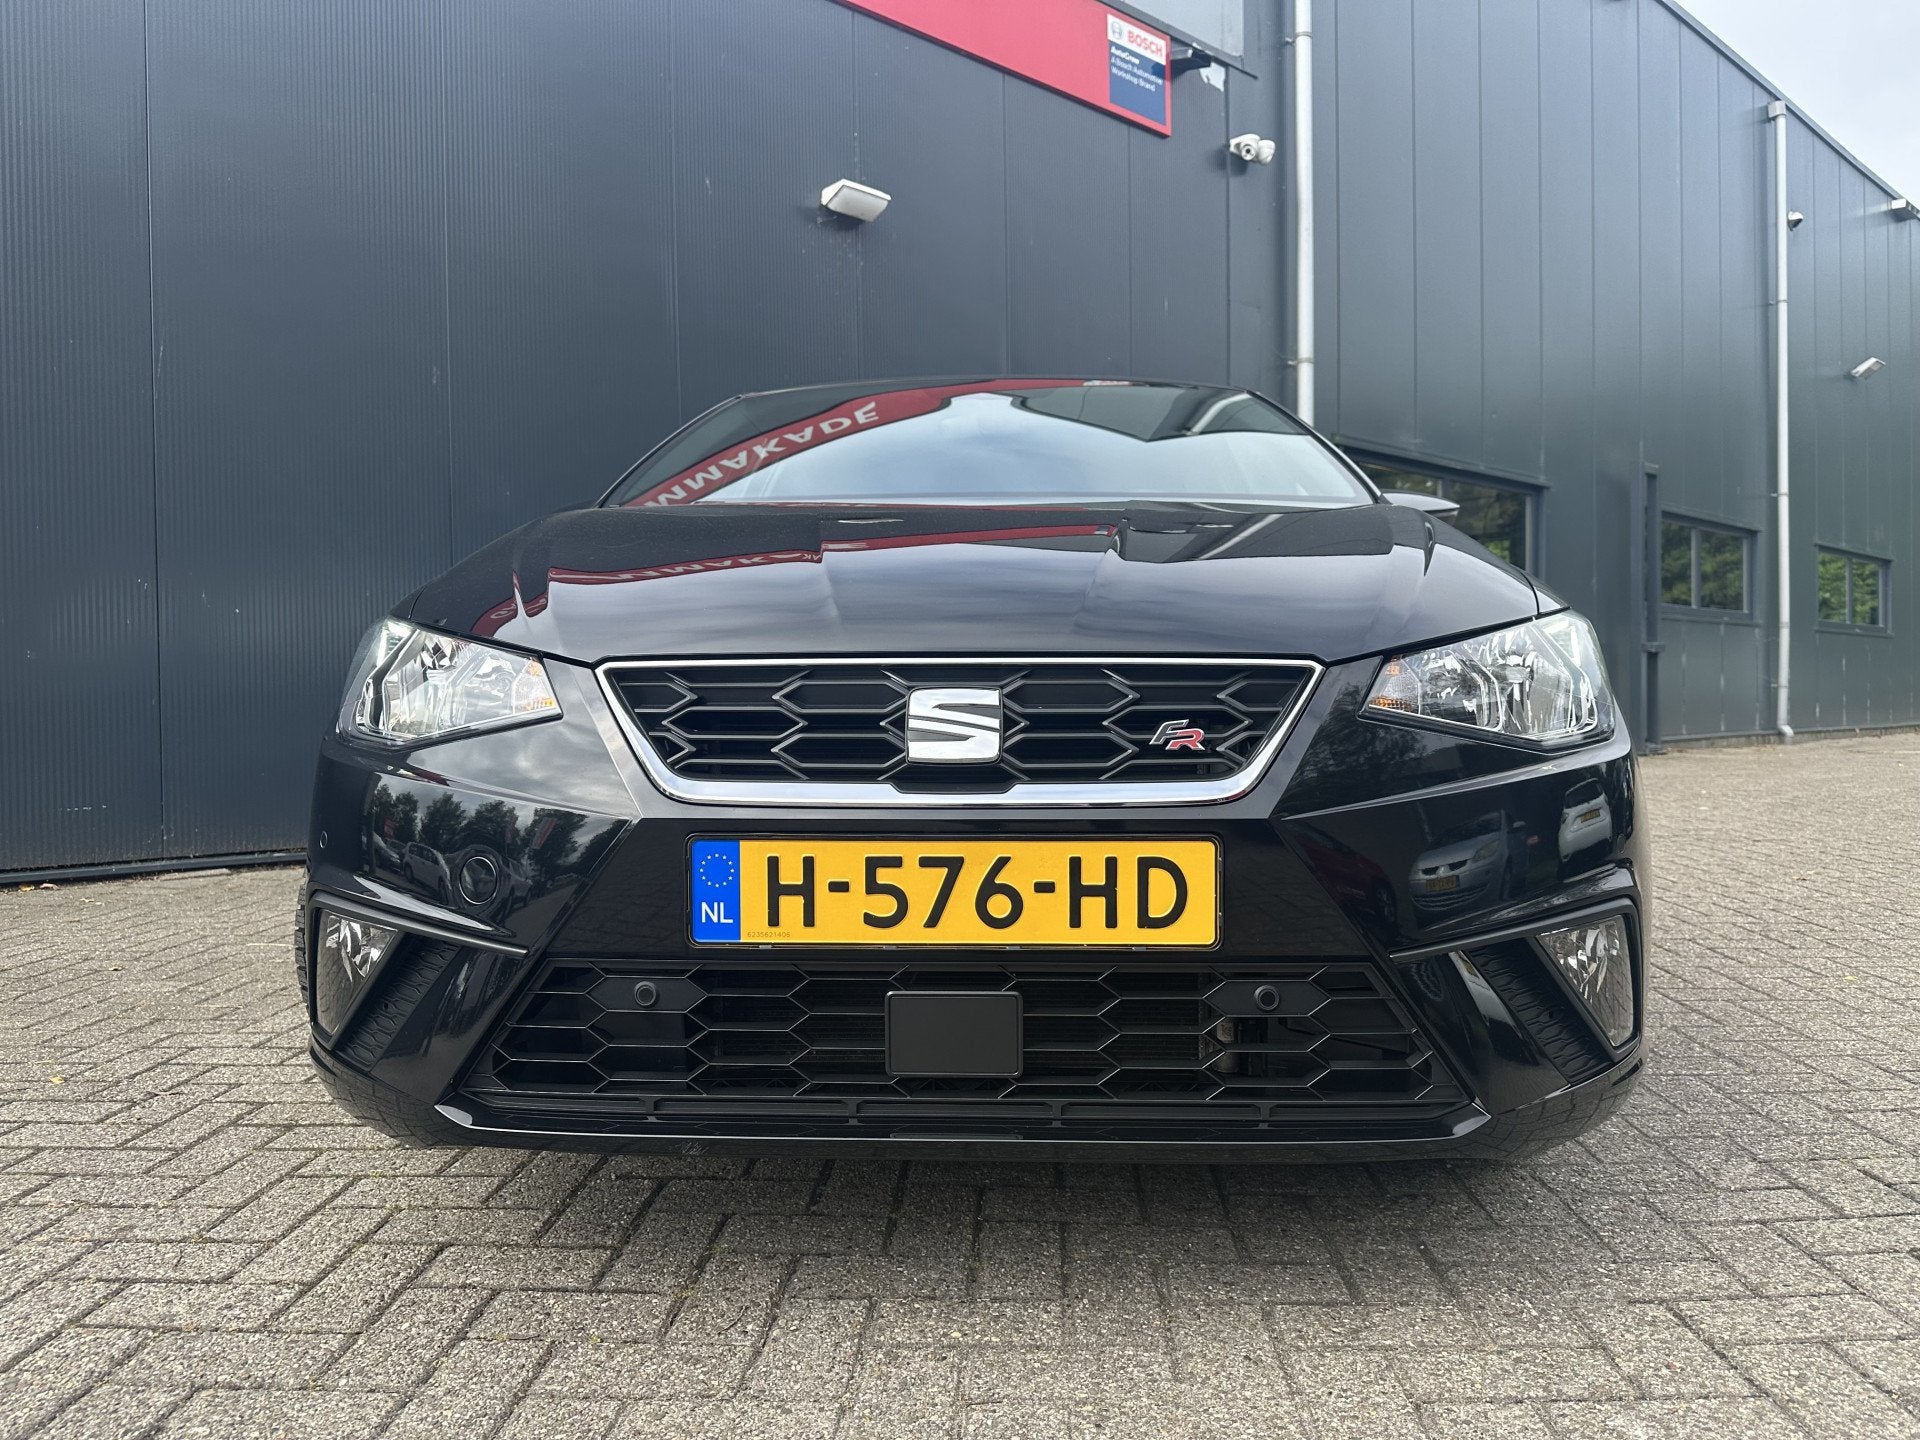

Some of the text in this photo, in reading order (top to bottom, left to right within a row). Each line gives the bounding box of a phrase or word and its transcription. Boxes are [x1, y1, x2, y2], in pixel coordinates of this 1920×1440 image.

[1127, 30, 1163, 57] BOSCH
[1149, 719, 1206, 750] FR
[766, 856, 1188, 929] H-576-HD
[701, 902, 733, 924] NL
